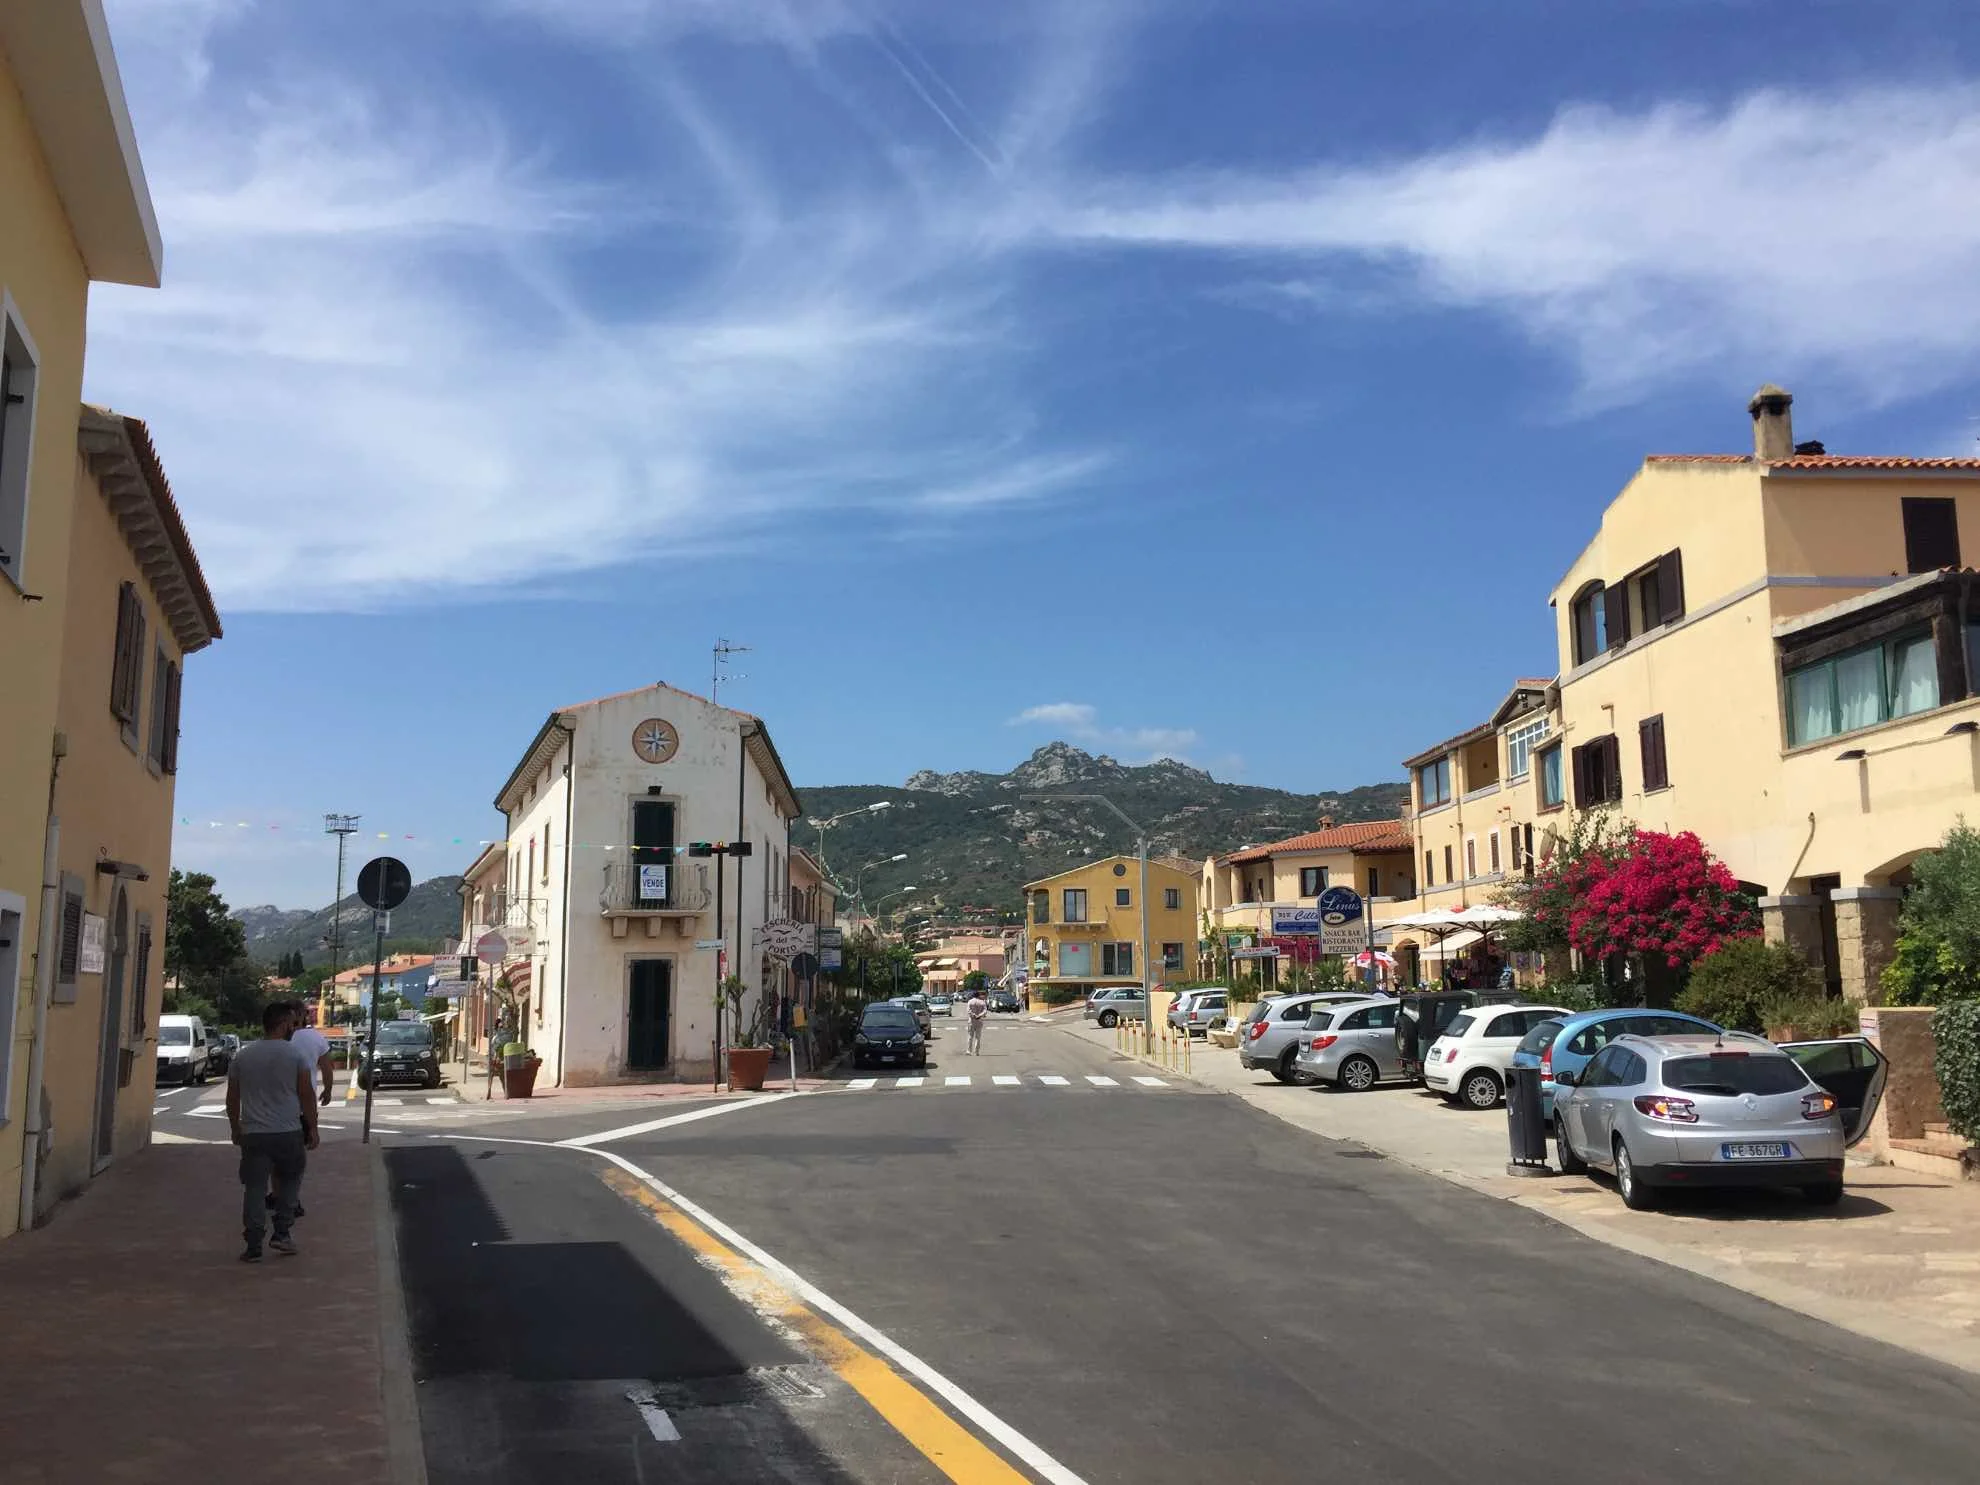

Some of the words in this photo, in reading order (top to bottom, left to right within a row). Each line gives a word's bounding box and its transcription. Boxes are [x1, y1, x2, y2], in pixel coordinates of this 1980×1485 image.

[642, 879, 664, 888] VENDE
[761, 917, 804, 934] PESCHERIA
[776, 936, 787, 944] del
[1322, 937, 1364, 945] RISTORANTE
[768, 944, 797, 954] PORTO
[1328, 945, 1359, 953] PIZZERIA
[1731, 1145, 1745, 1157] FE
